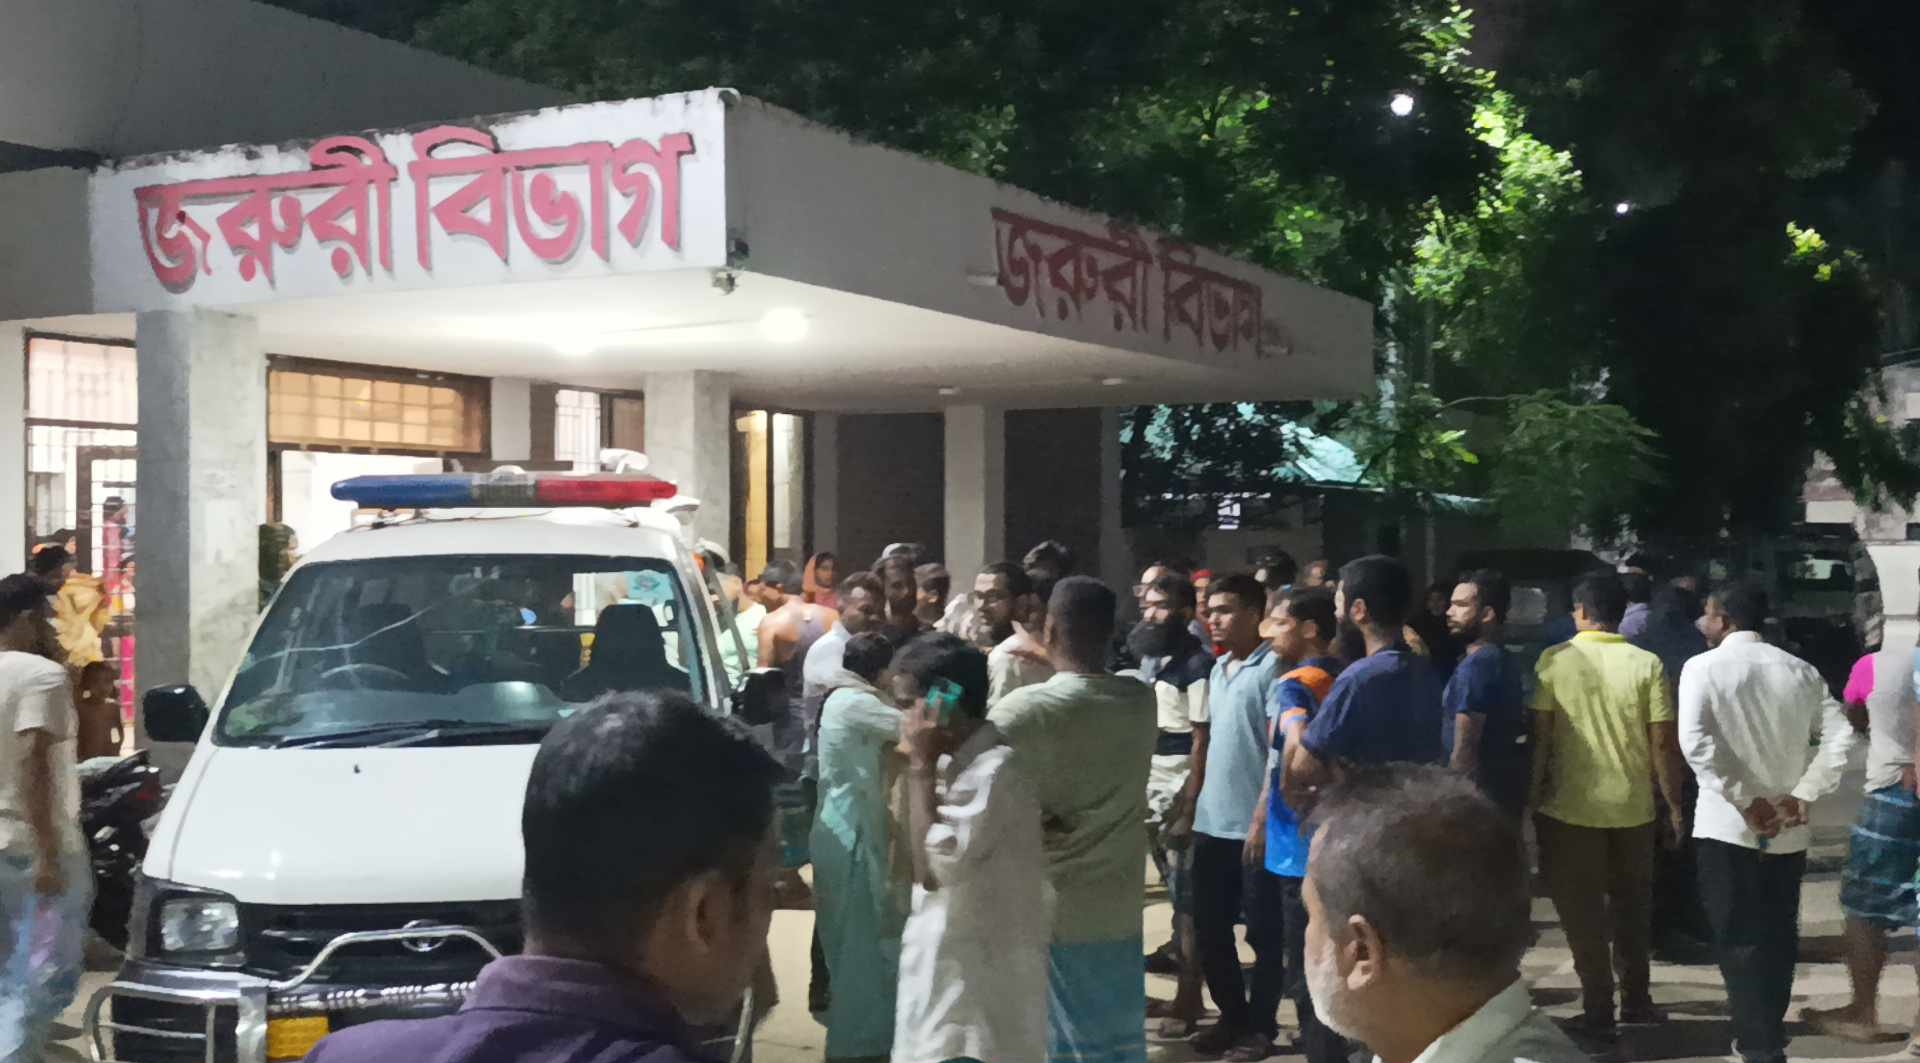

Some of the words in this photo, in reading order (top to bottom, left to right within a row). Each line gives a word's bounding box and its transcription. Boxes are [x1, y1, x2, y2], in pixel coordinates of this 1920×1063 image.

[134, 135, 398, 293] জরুরী
[408, 126, 695, 271] বিভাগ
[991, 207, 1155, 333] জরুরী
